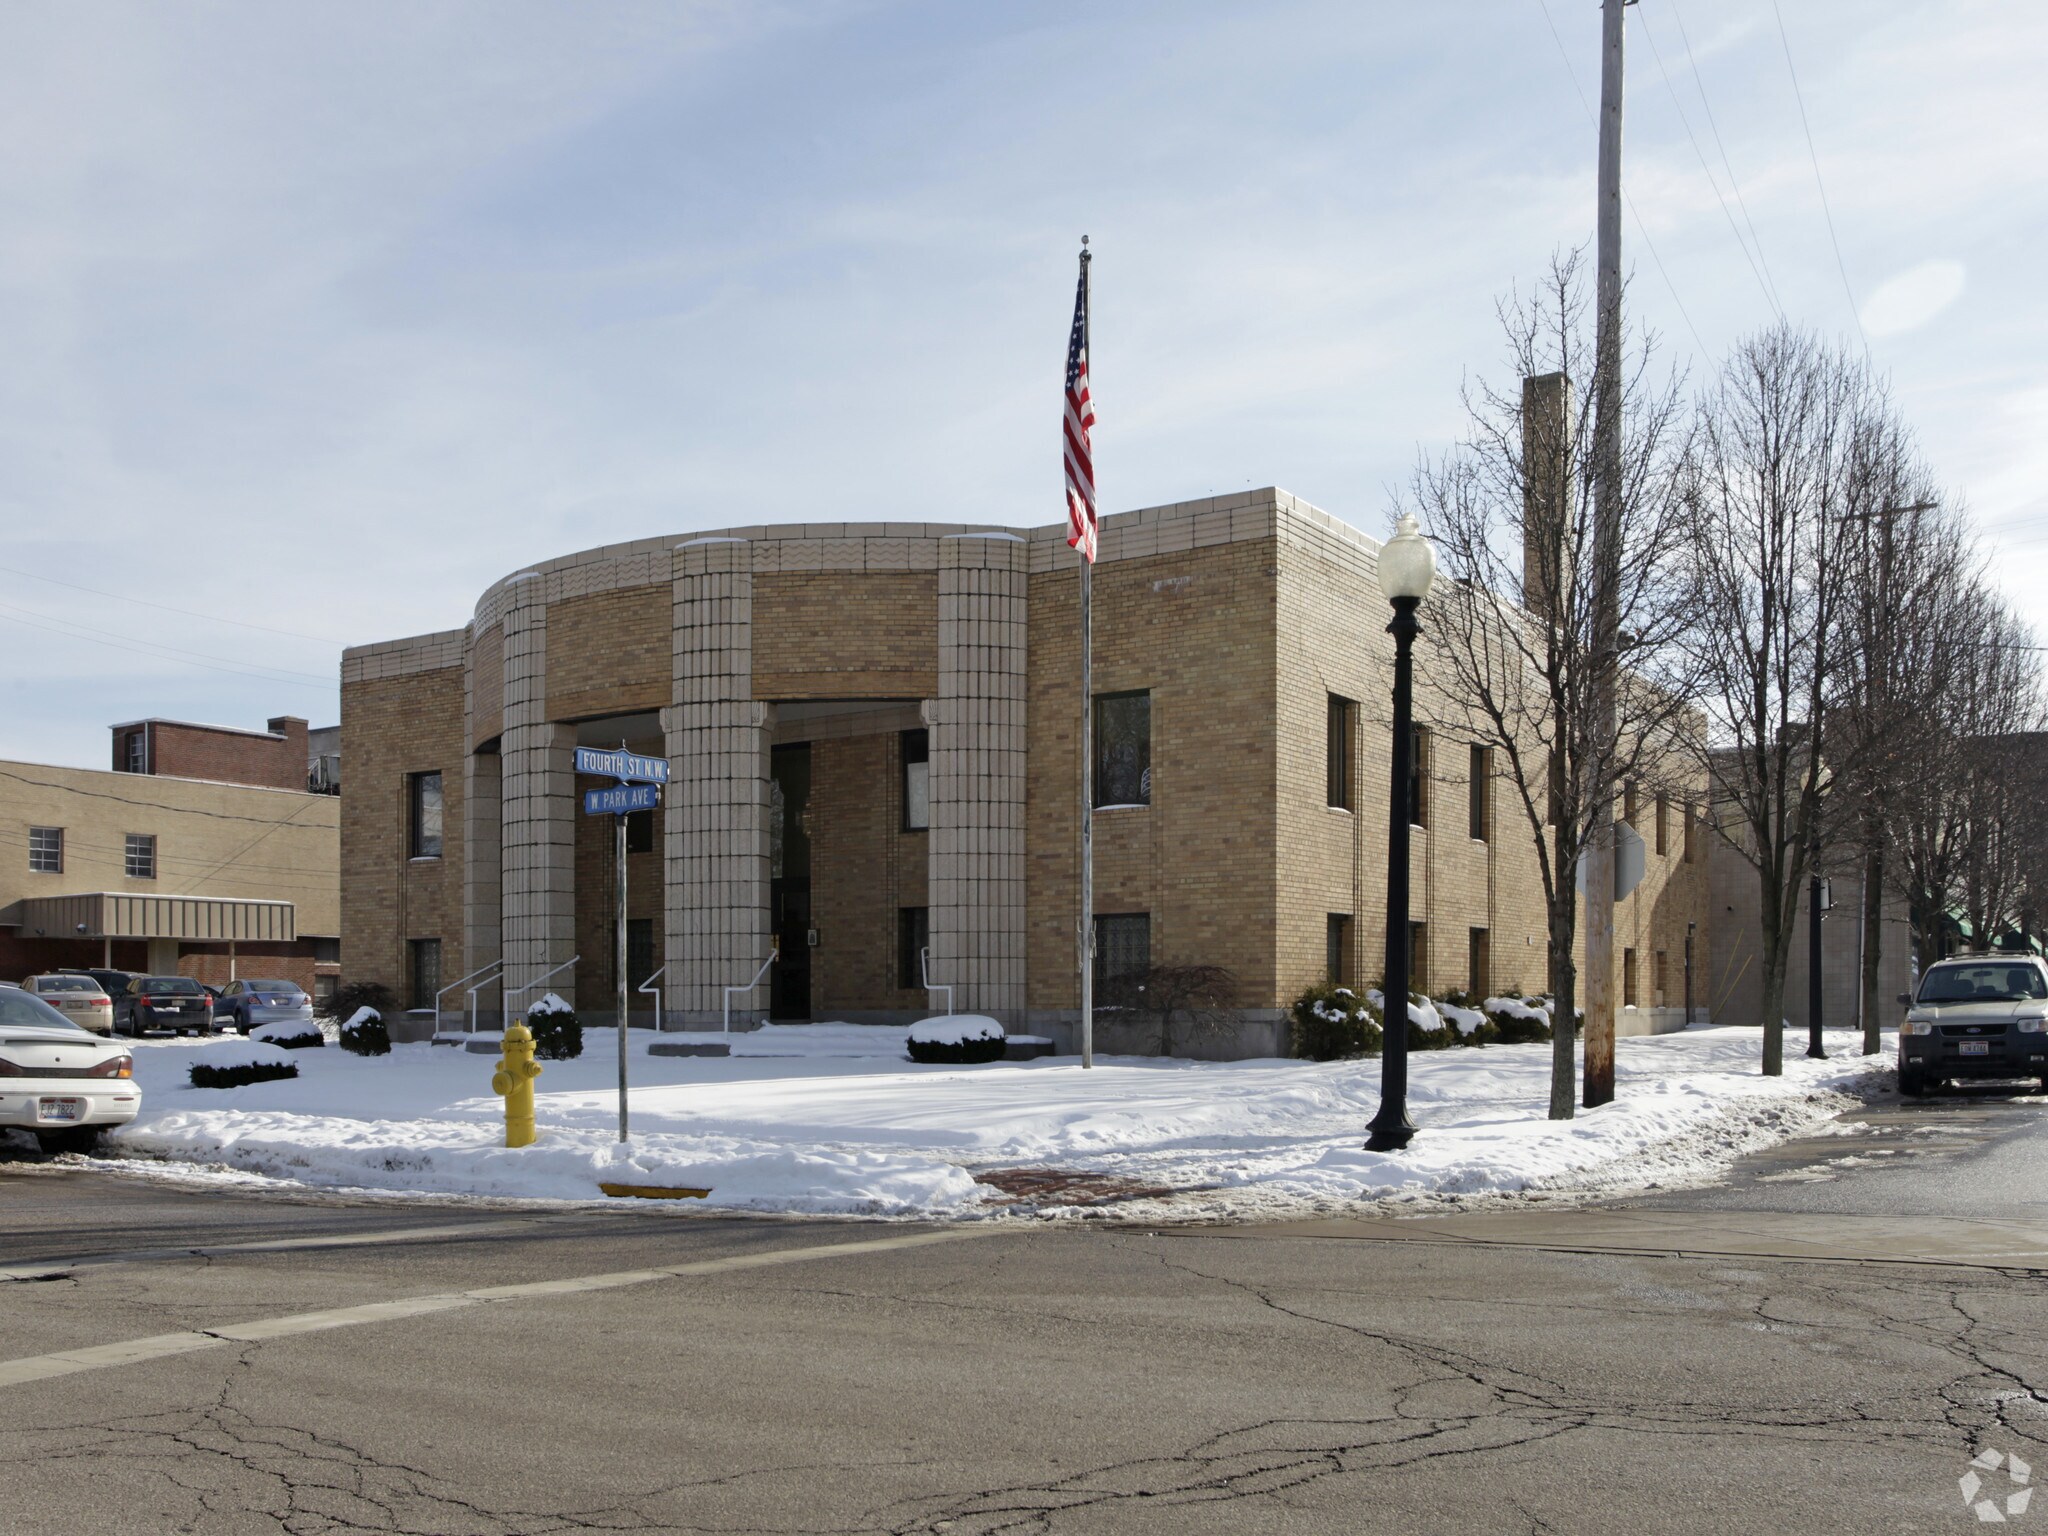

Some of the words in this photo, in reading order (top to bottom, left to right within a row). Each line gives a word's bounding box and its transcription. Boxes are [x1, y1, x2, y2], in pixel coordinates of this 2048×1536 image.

[583, 752, 623, 773] FOURTH
[628, 758, 640, 774] ST
[644, 760, 664, 778] N.W.
[591, 793, 598, 809] W
[603, 791, 627, 809] PARK
[631, 788, 648, 805] AVE
[56, 1104, 74, 1115] 7822
